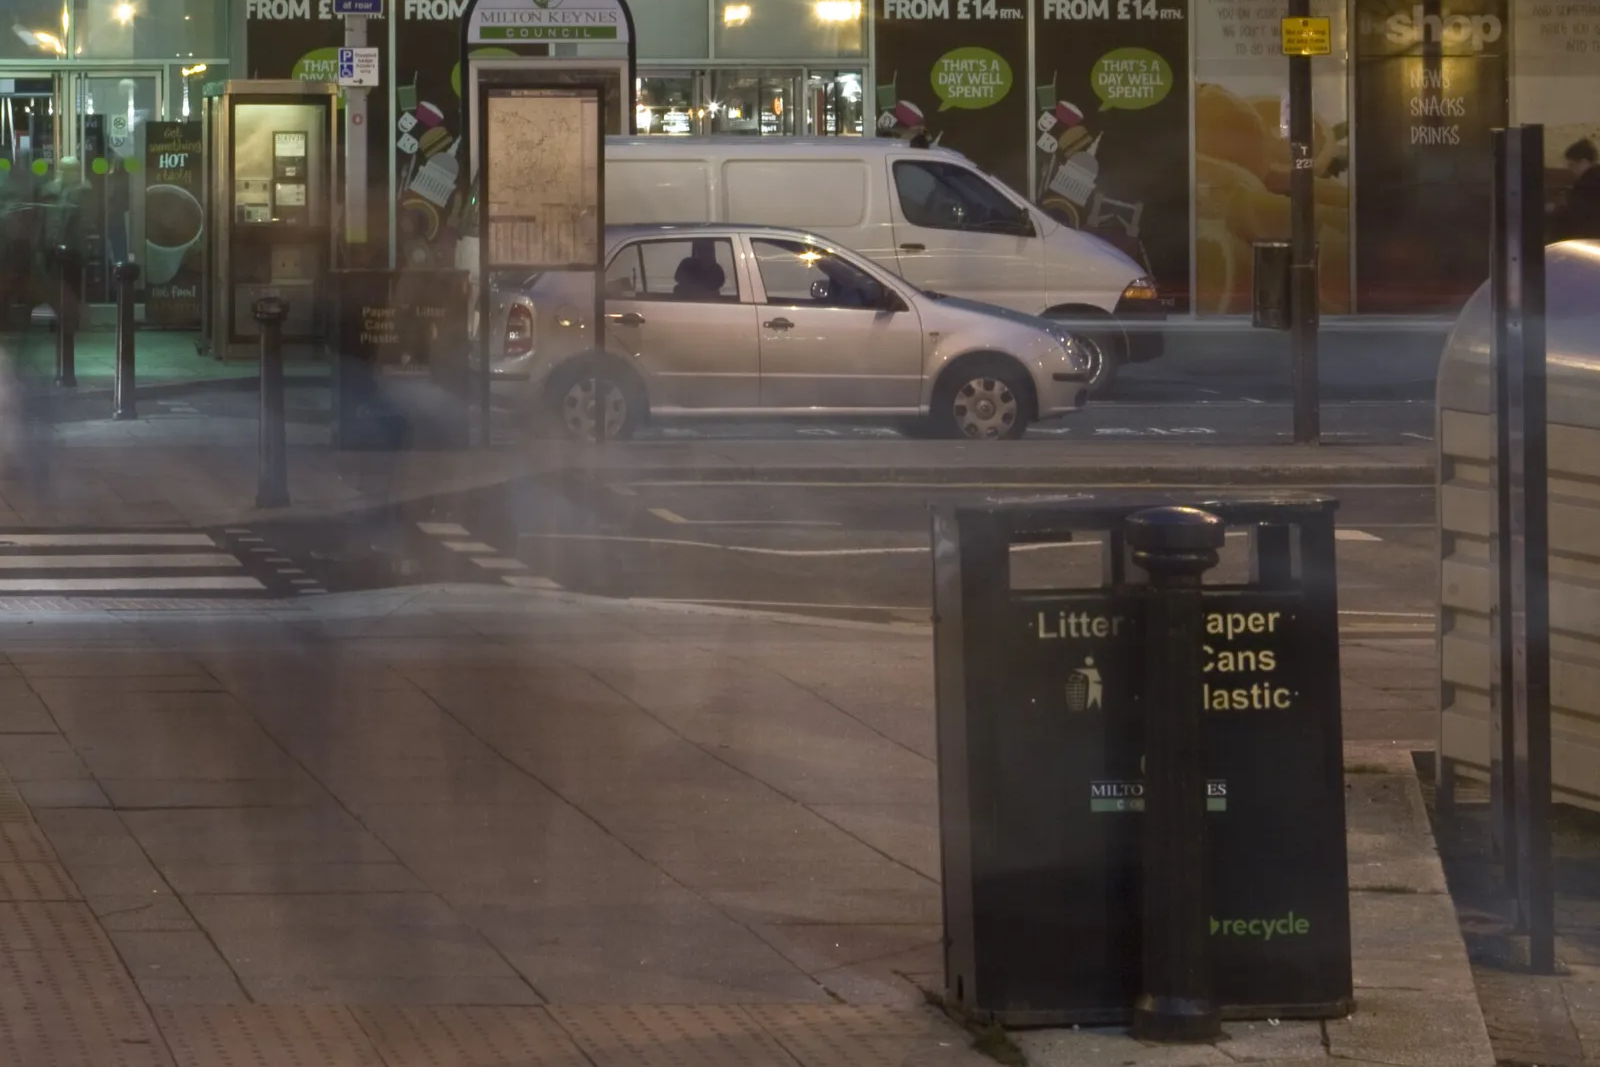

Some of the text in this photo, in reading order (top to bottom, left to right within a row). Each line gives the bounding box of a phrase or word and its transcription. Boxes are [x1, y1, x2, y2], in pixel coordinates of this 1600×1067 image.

[246, 0, 310, 20] FROM
[343, 1, 373, 10] at rear
[480, 11, 617, 23] MILTON KEYNES
[999, 9, 1024, 20] RTN.
[1160, 9, 1184, 20] RTN.
[506, 28, 591, 38] COUNCIL
[1386, 5, 1502, 50] shop
[343, 51, 352, 62] P
[303, 60, 336, 72] THAT
[942, 59, 1000, 72] THAT'S A
[1102, 59, 1161, 72] THAT'S A
[938, 73, 1004, 85] DAY WELL
[1098, 73, 1164, 85] DAY WELL
[948, 86, 993, 99] SPENT!
[1108, 86, 1154, 99] SPENT!
[1410, 95, 1466, 117] SNACKS
[1410, 124, 1461, 145] DRINKS
[1300, 145, 1309, 156] T
[159, 153, 189, 168] HOT
[1038, 611, 1125, 639] Litter
[1203, 611, 1281, 640] aper
[1204, 682, 1292, 710] lastic
[1090, 785, 1143, 797] MILTO
[1222, 910, 1310, 941] recycle
